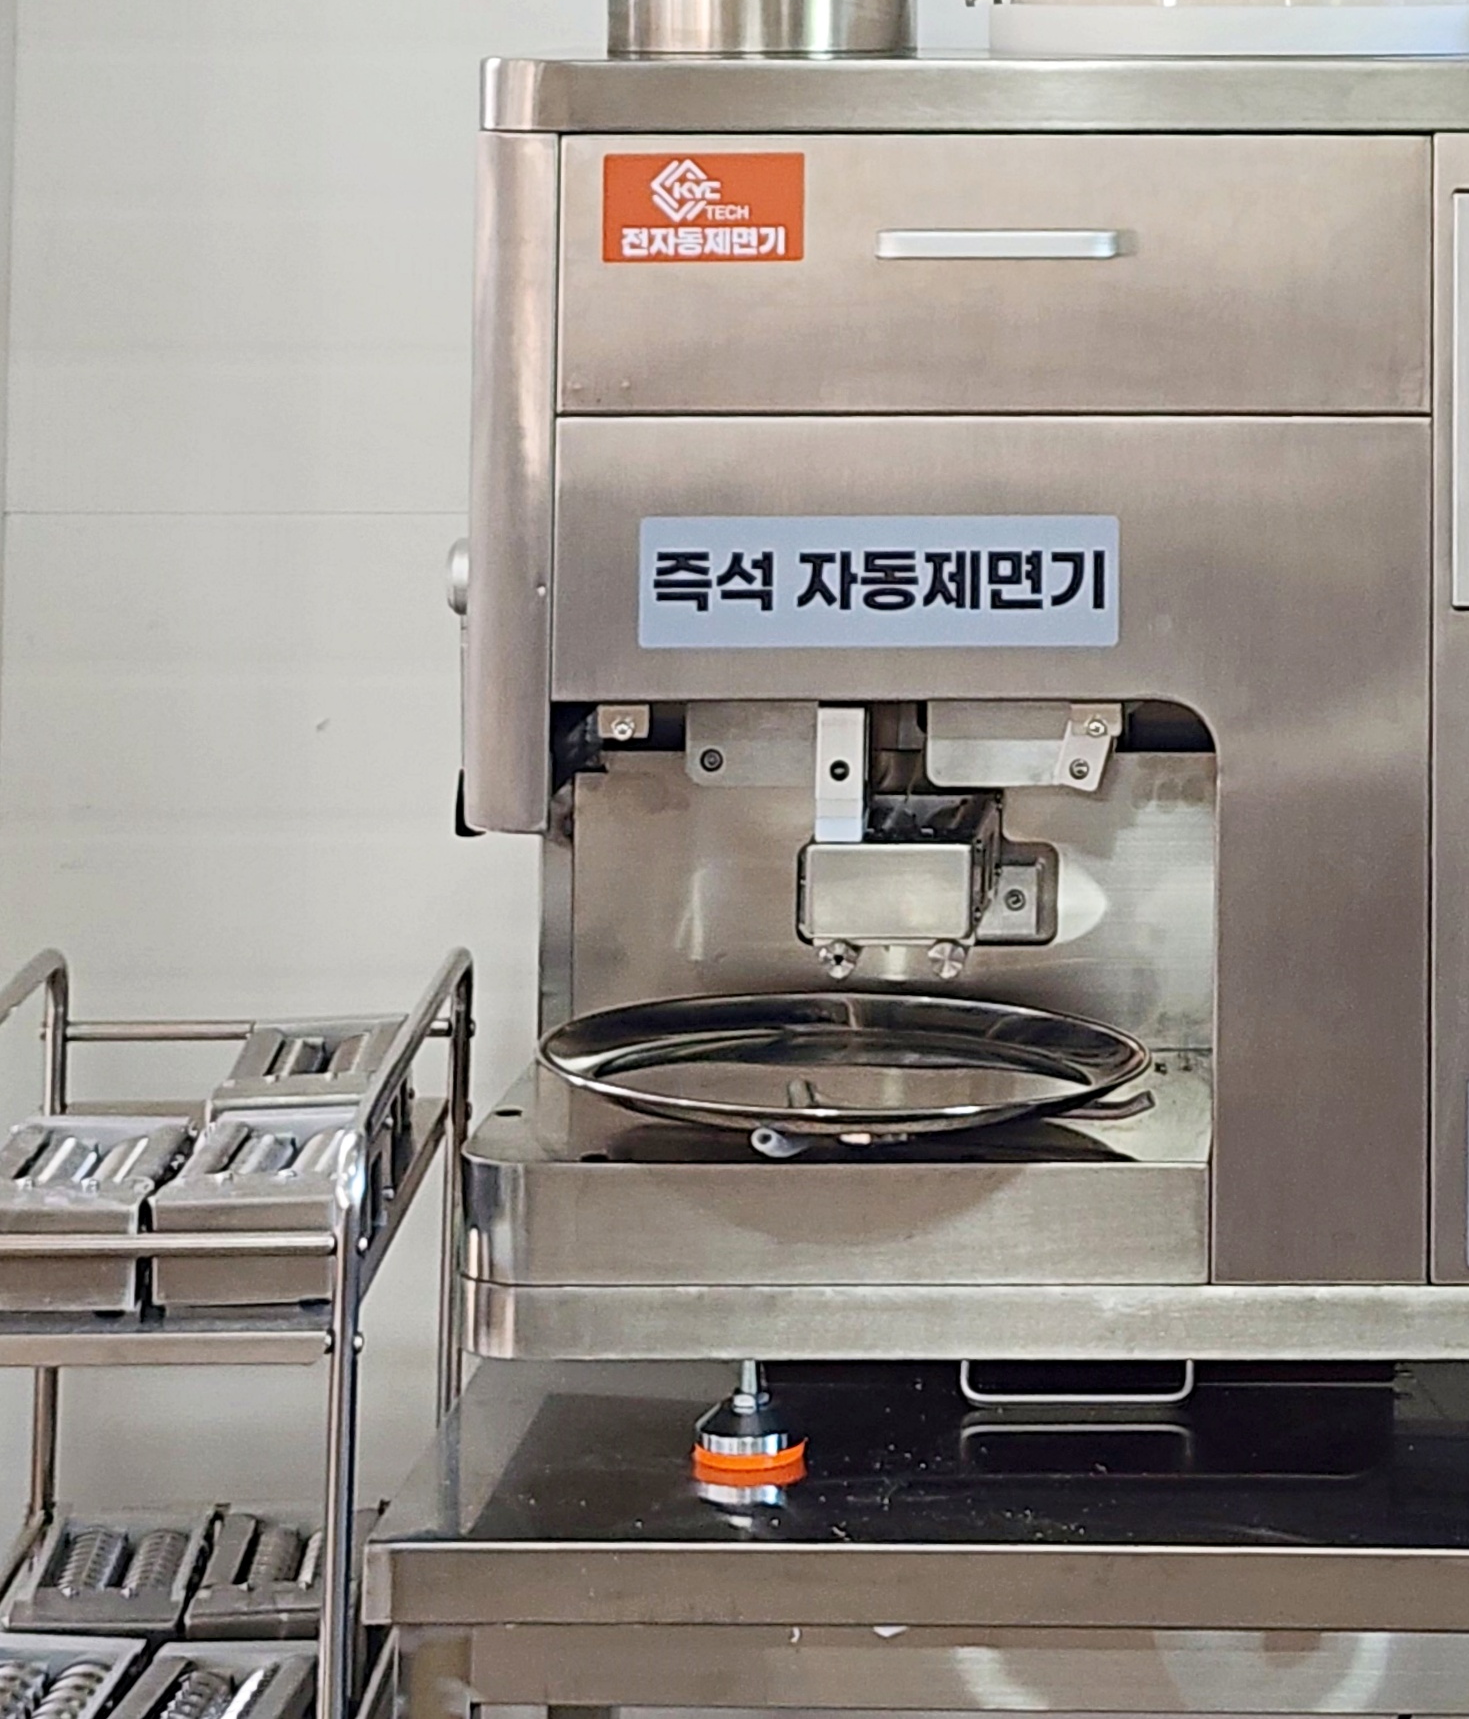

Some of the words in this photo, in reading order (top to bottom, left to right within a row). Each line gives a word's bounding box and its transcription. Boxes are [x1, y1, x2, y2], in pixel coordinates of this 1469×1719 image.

[673, 181, 721, 200] KYC
[705, 205, 749, 220] TECH
[621, 226, 786, 256] 전자동제면기
[653, 551, 774, 611] 즉석
[797, 550, 1106, 611] 자동제면기
